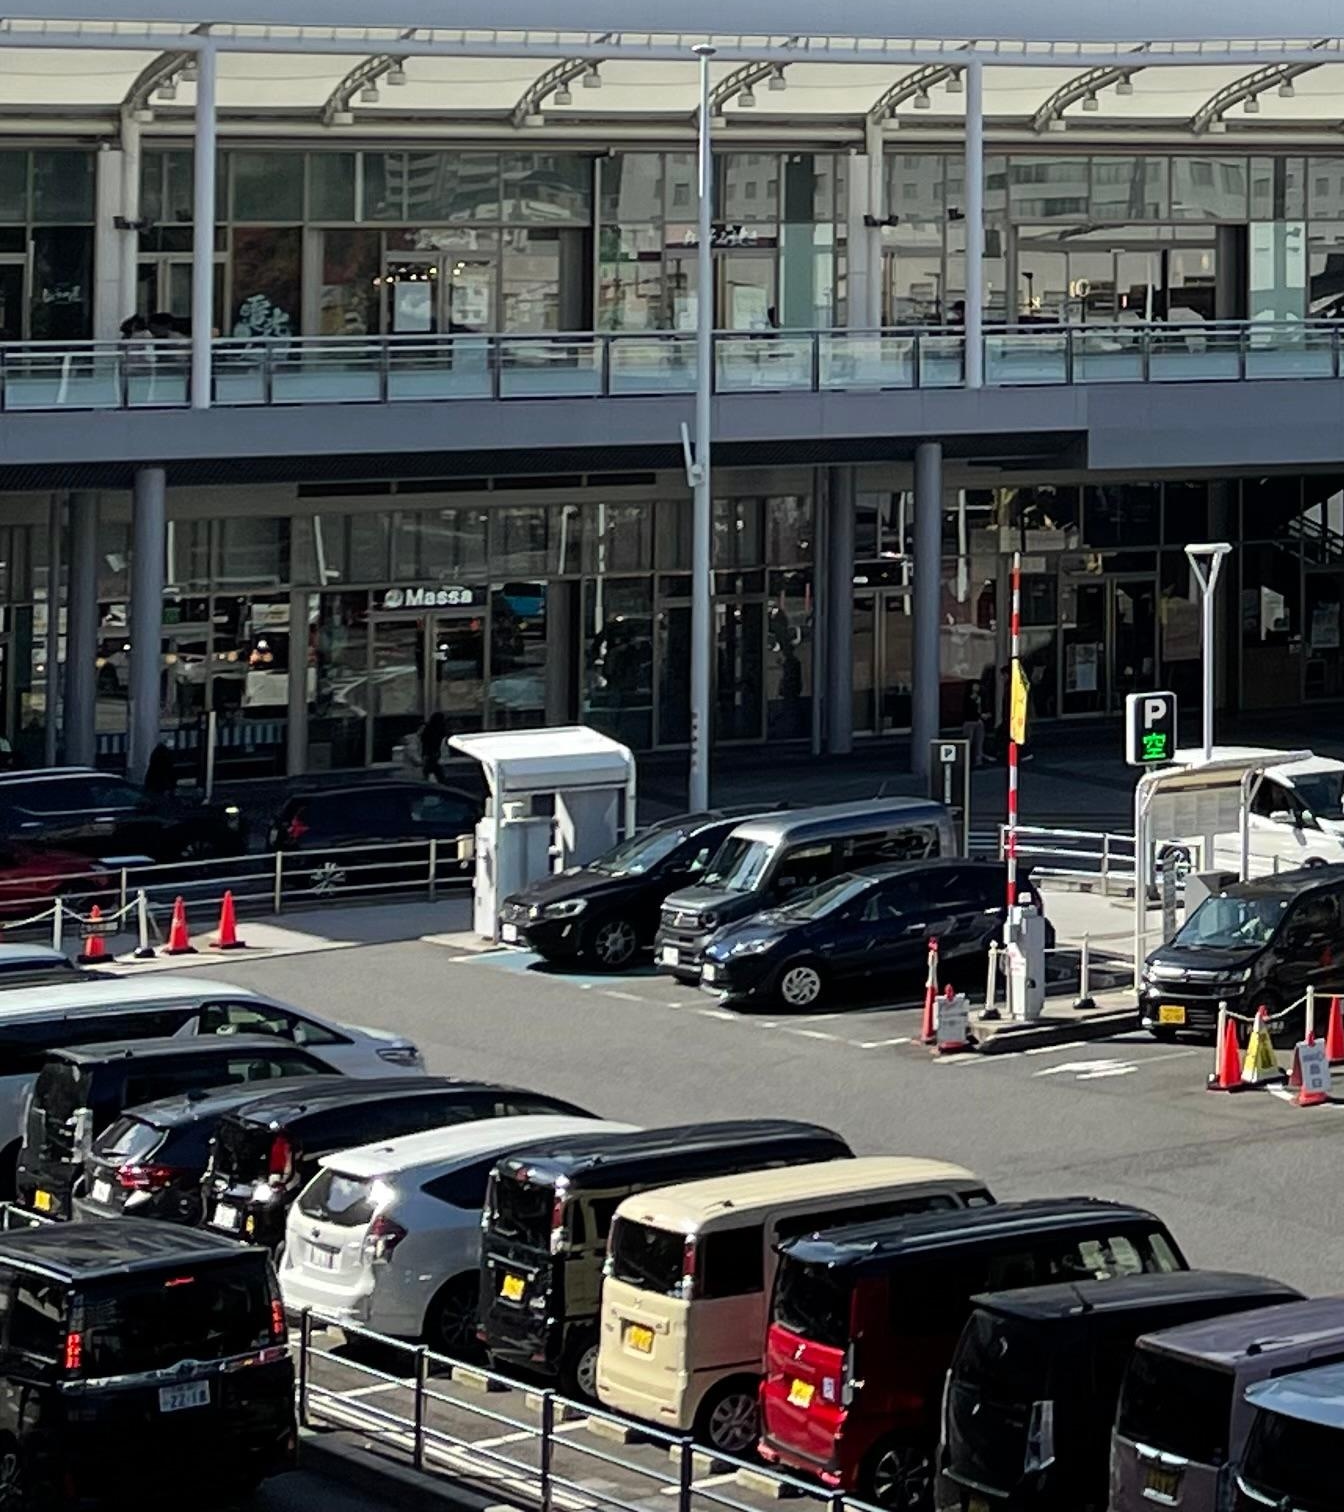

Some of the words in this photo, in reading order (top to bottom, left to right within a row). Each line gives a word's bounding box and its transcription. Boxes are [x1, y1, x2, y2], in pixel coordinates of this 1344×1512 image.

[405, 587, 473, 606] Massa
[1144, 698, 1167, 729] P
[1142, 732, 1167, 760] 空
